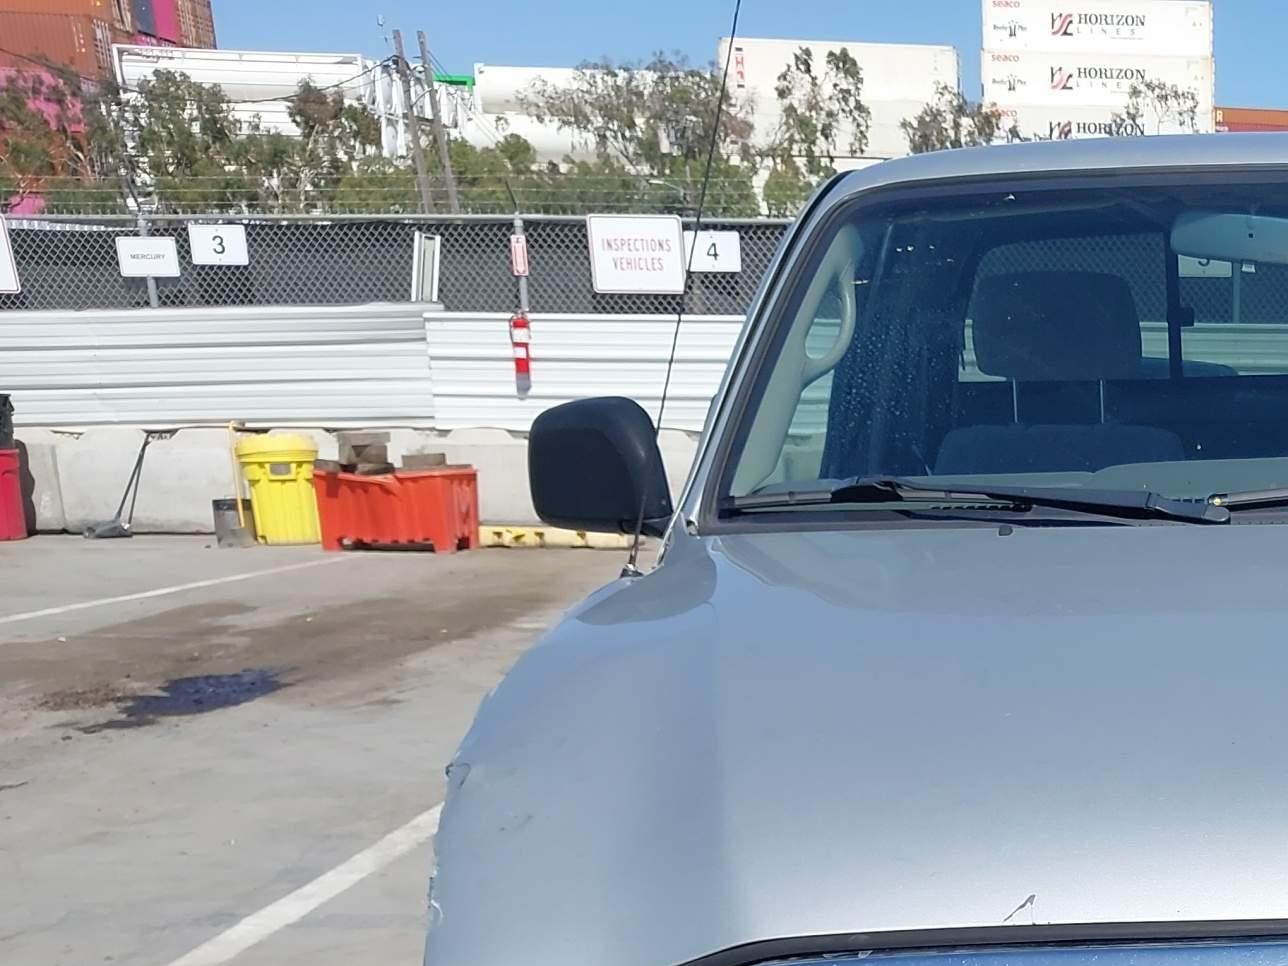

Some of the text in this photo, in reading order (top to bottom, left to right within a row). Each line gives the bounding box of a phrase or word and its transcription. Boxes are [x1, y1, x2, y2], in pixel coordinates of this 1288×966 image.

[1077, 13, 1146, 26] HORIZON
[1076, 26, 1137, 36] LINES
[1077, 67, 1146, 81] HORIZON
[212, 235, 226, 254] 3
[601, 237, 672, 253] INSPECTIONS
[706, 242, 719, 261] 4
[612, 257, 665, 272] VEHICLES
